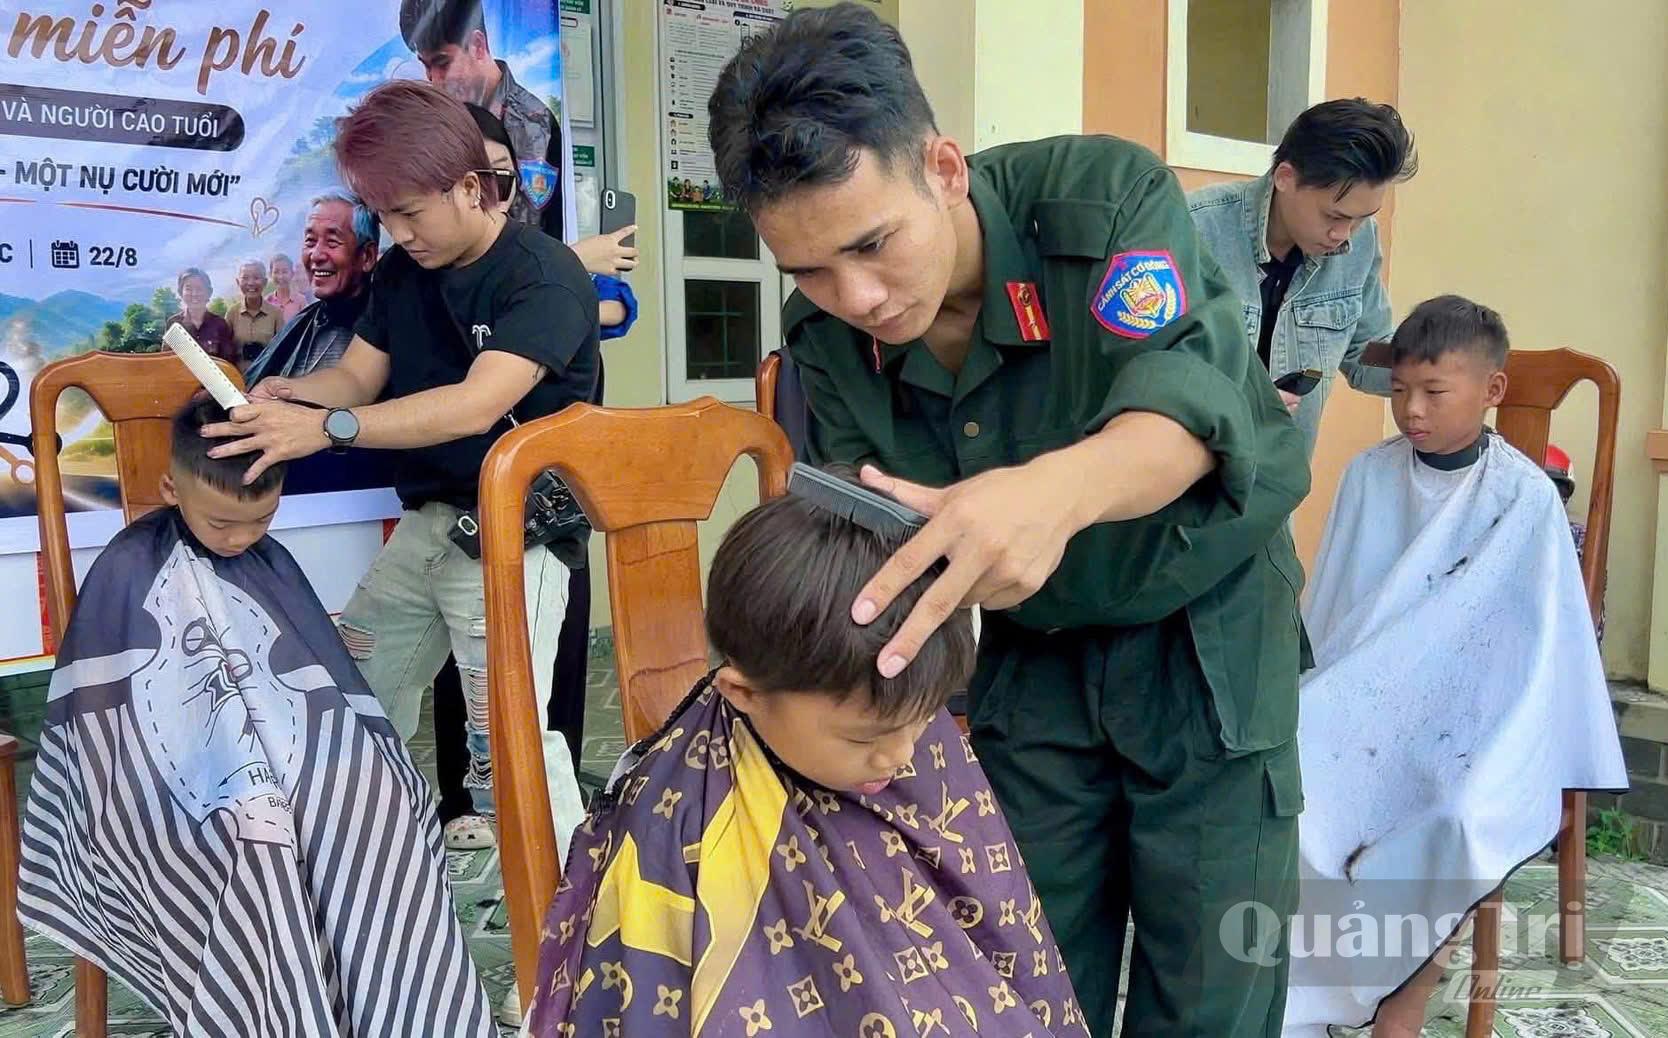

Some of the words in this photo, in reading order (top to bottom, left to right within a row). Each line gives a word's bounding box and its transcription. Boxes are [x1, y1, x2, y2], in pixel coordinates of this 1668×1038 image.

[7, 0, 187, 71] miễn
[197, 9, 306, 96] phí
[1, 97, 32, 122] VÀ
[41, 104, 114, 129] NGƯỜI
[121, 111, 166, 133] CAO
[172, 111, 219, 138] TUỔI
[15, 157, 73, 191] MỘT
[79, 165, 115, 194] NỤ
[122, 165, 179, 194] CƯỜI
[89, 246, 138, 268] 22/8
